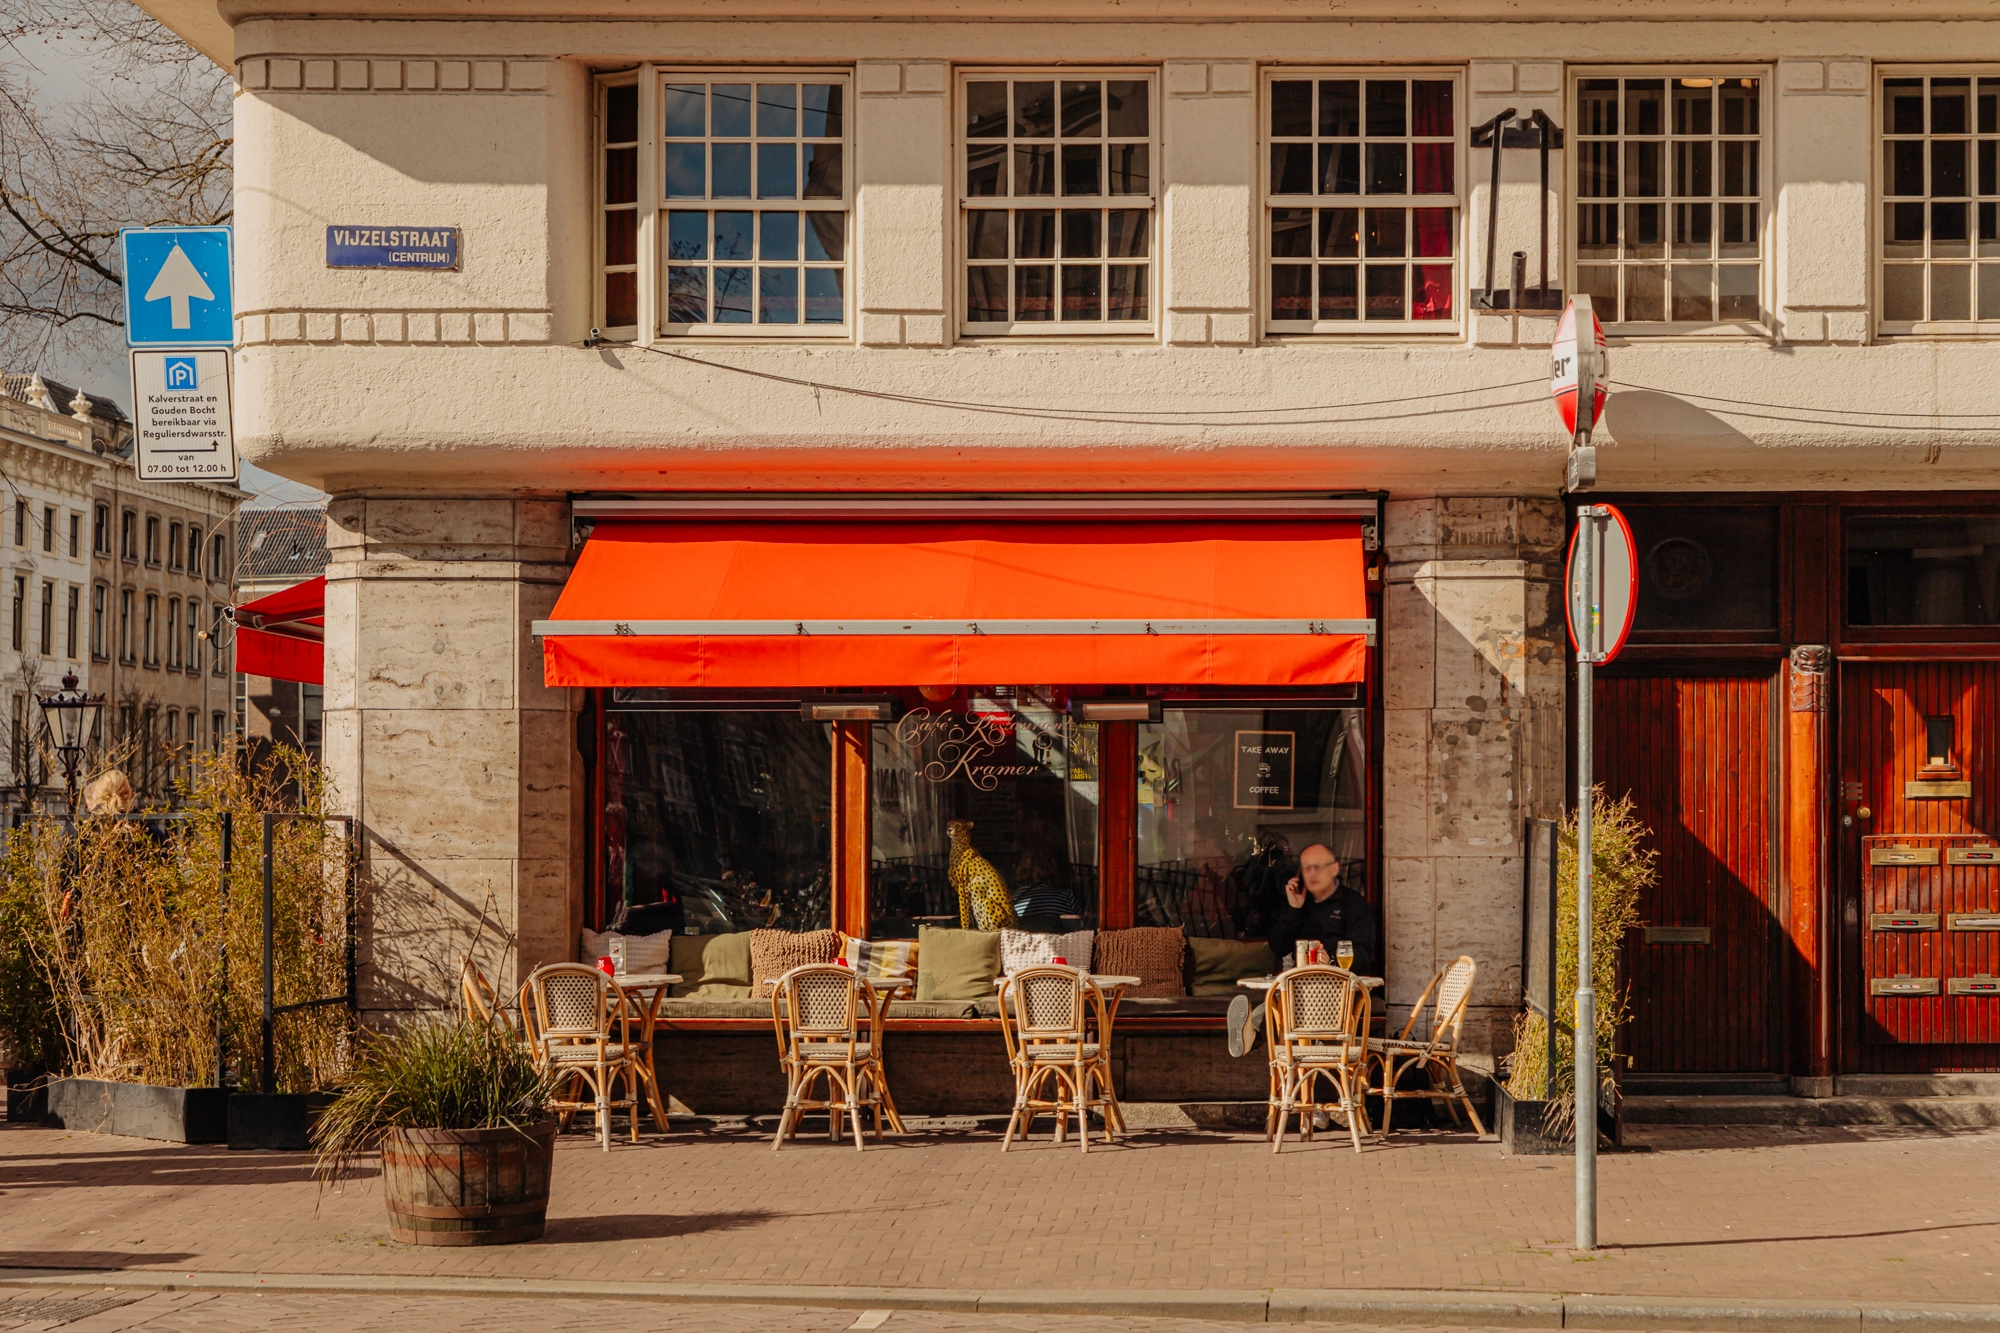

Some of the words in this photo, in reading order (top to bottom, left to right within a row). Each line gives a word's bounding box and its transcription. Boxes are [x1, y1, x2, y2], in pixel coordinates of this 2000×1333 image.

[334, 230, 450, 247] VIJZELSTRAAT
[388, 251, 450, 264] (CENTRUM)
[148, 394, 204, 403] Kalverstraat
[151, 406, 187, 415] Gouden
[189, 406, 216, 415] Bocht
[152, 418, 201, 427] bereikbaar
[203, 418, 217, 426] via
[143, 430, 227, 440] Reguliersdwarsstr.
[147, 464, 173, 473] 07.00
[176, 464, 190, 473] tot
[192, 464, 218, 473] 12.00
[220, 464, 227, 472] h
[1241, 746, 1262, 754] TAKE
[1249, 786, 1280, 794] COFFEE
